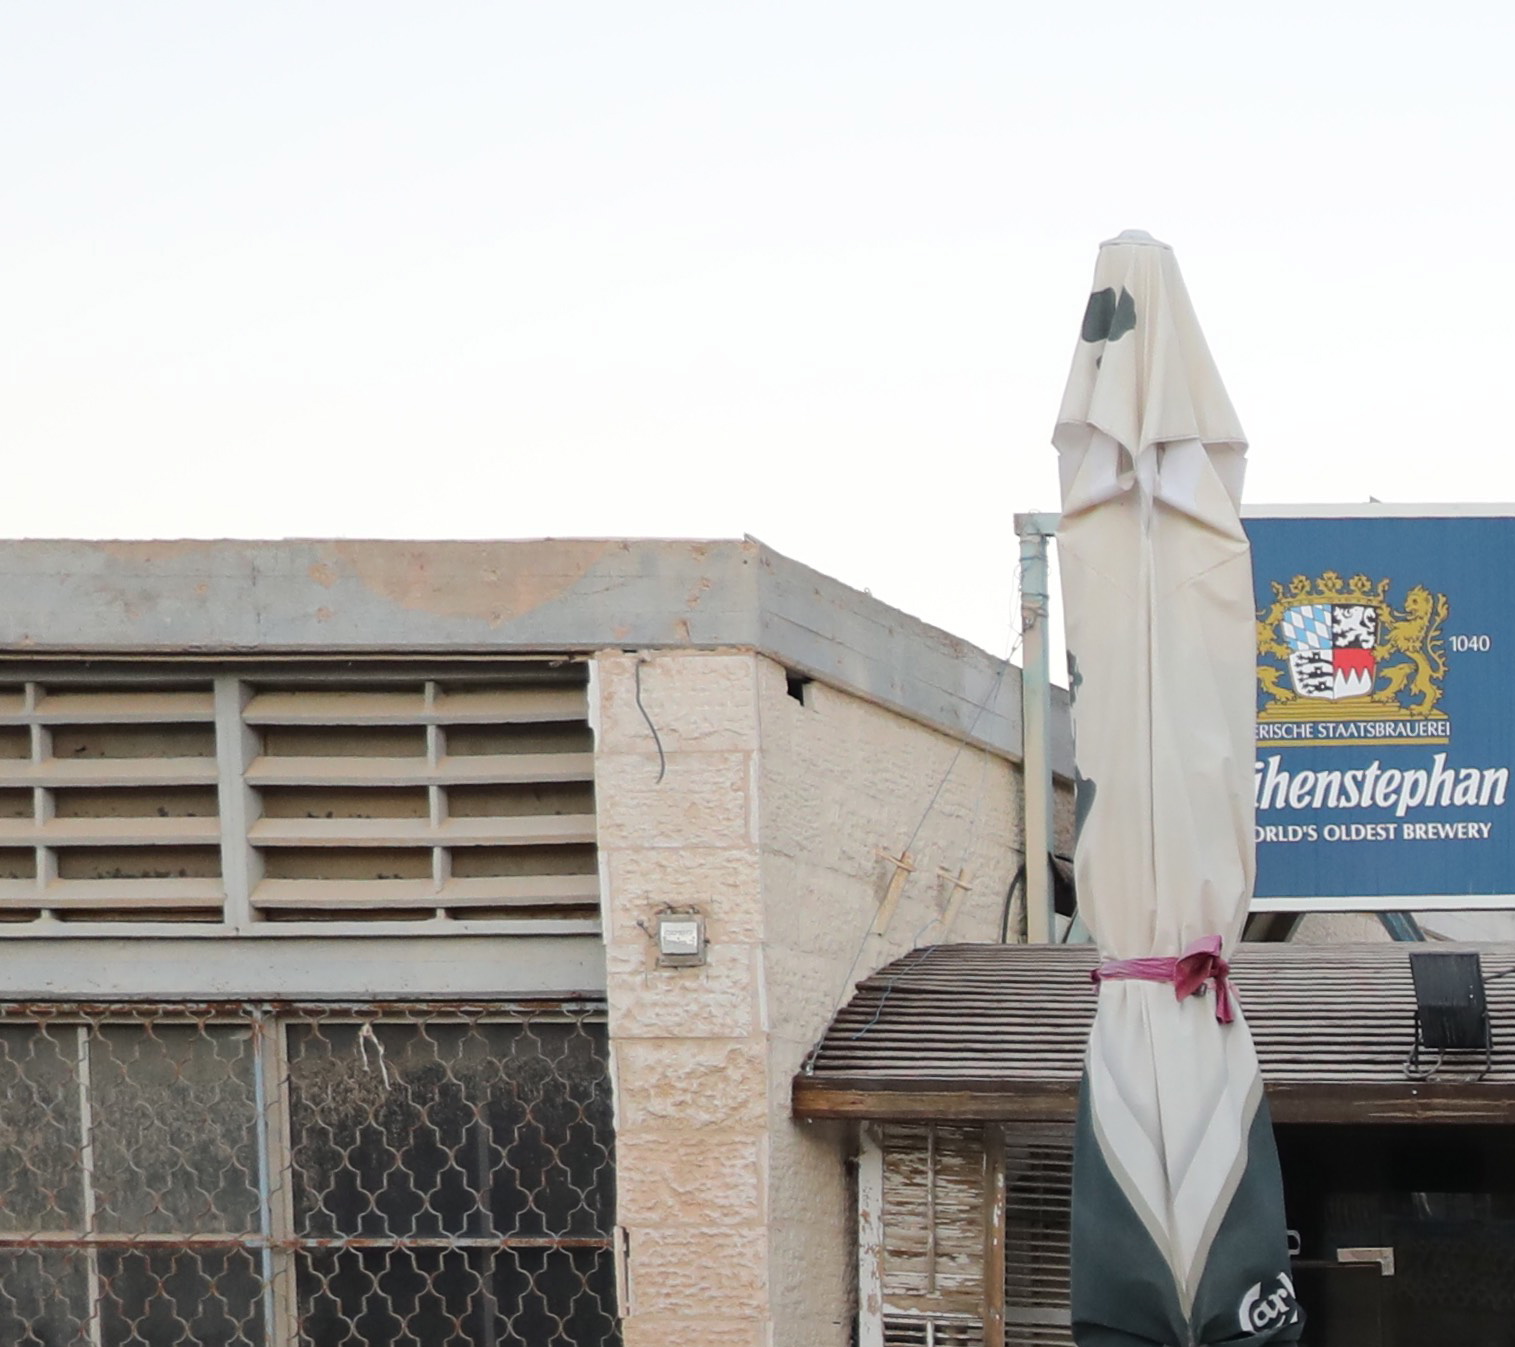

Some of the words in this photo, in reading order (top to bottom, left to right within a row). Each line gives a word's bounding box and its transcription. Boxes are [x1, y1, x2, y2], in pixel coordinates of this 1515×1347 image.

[1449, 633, 1491, 652] 1040
[1254, 725, 1313, 740] ERISCHE
[1318, 721, 1450, 738] STAATSBRAUEREI
[1254, 752, 1509, 817] ihenstephan
[1254, 823, 1318, 842] ORLD'S
[1323, 822, 1397, 841] OLDEST
[1402, 821, 1491, 840] BREWERY
